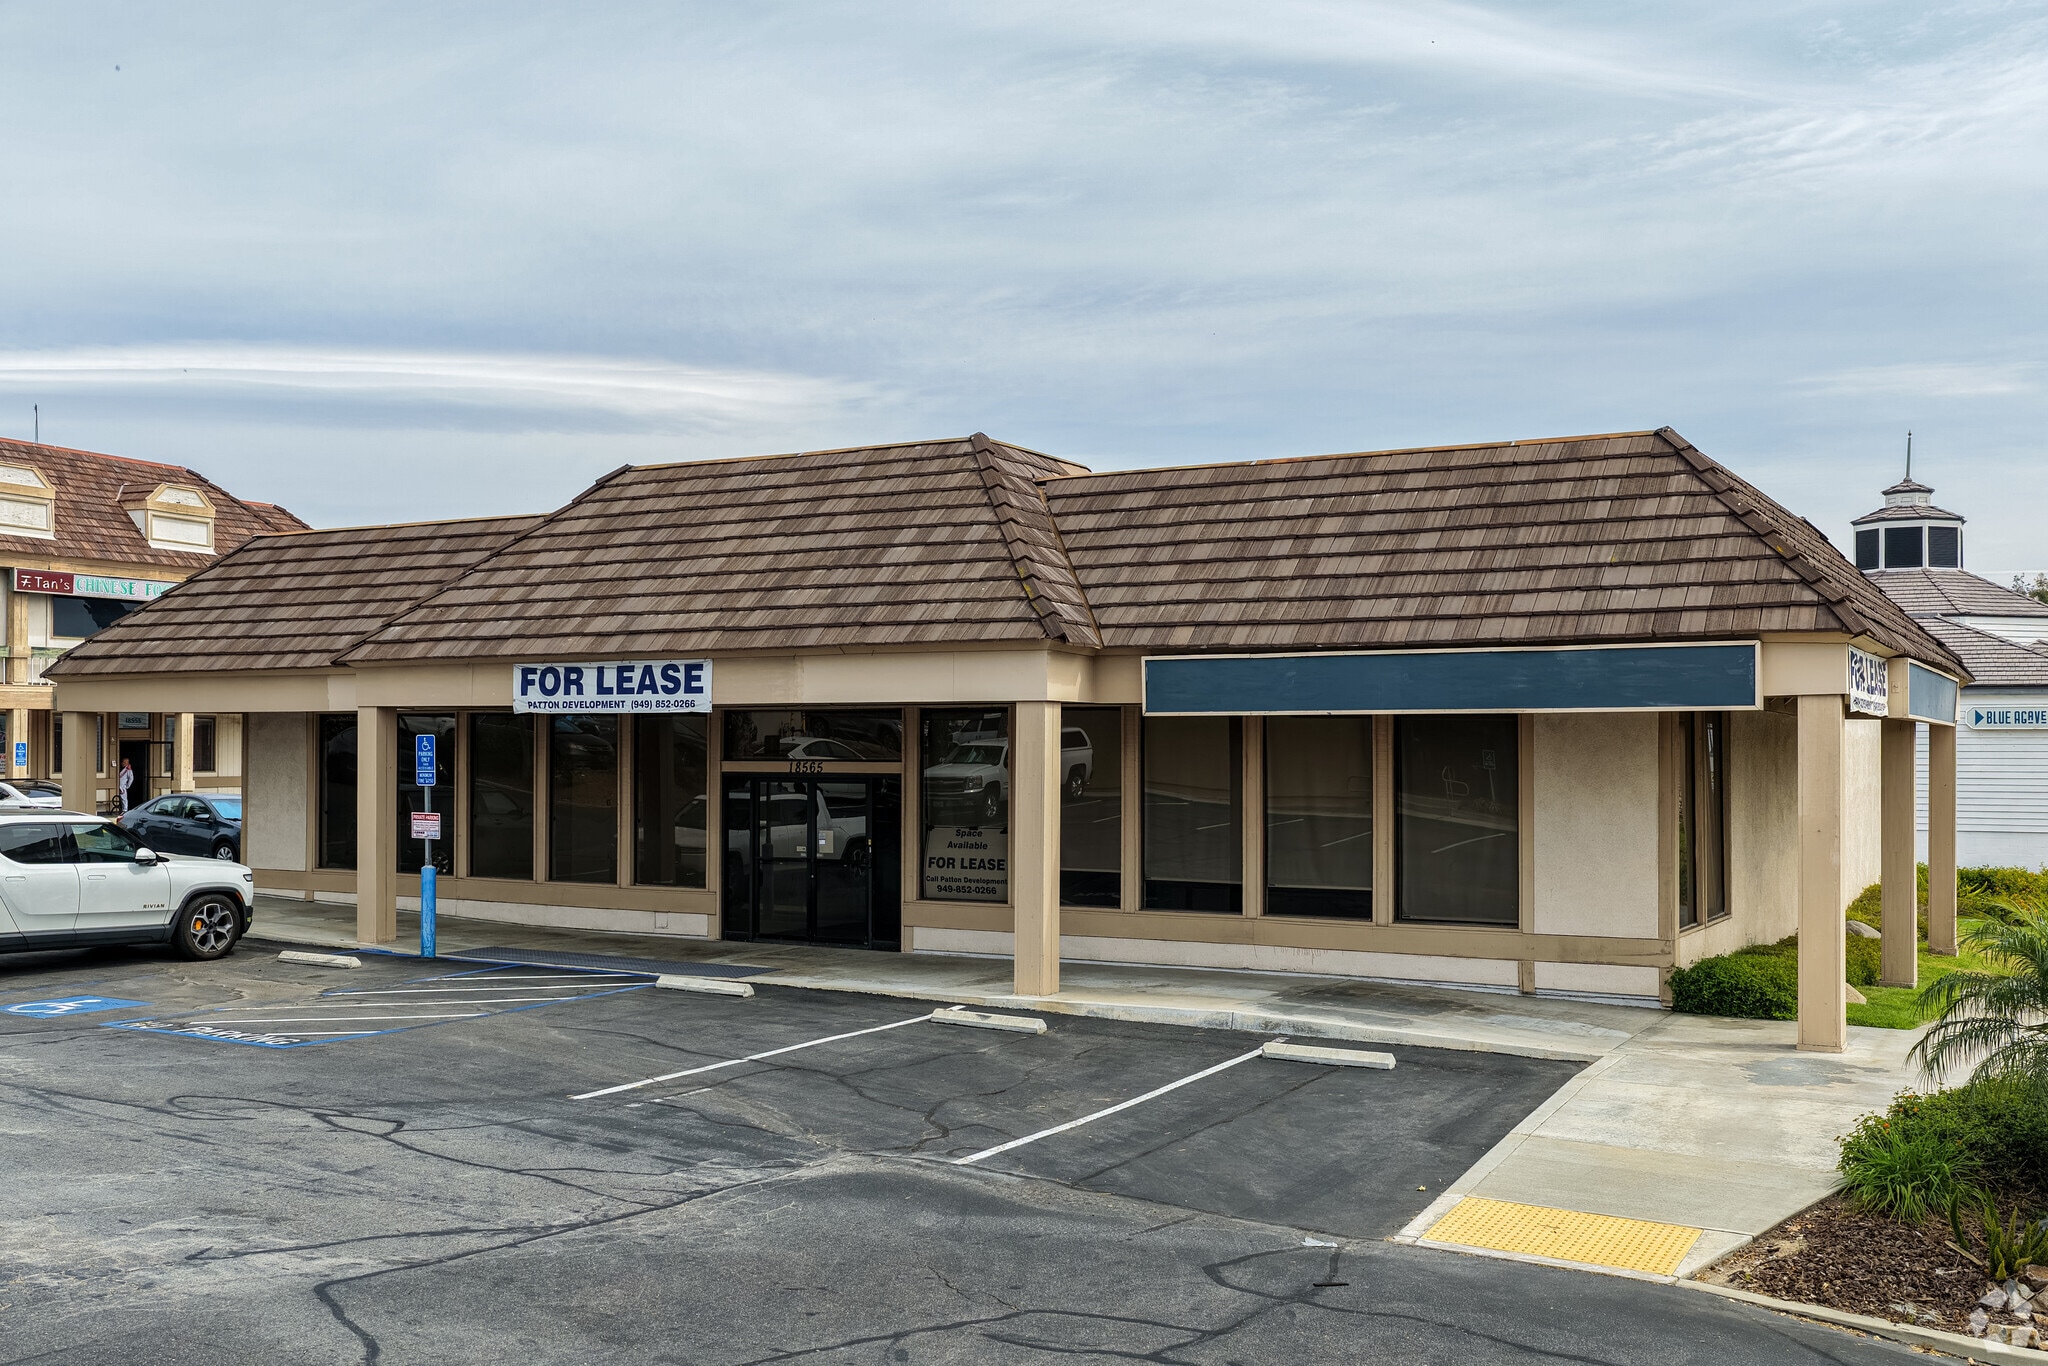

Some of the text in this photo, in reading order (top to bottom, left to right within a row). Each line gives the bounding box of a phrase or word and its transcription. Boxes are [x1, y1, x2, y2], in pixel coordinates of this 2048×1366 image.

[34, 576, 71, 591] Tan's
[75, 576, 138, 596] CHINESE
[1850, 650, 1865, 692] FOR
[520, 663, 704, 697] FOR LEASE
[527, 699, 696, 710] PATTON DEVELOPMENT (949) 852-0266
[1986, 710, 2047, 724] BLUE AGAVE
[789, 761, 824, 773] 18565
[955, 829, 983, 839] Space
[947, 841, 988, 850] Available
[928, 856, 1006, 871] FOR LEASE
[963, 877, 1008, 885] Development
[937, 885, 997, 895] 949-852-0266
[172, 1026, 301, 1045] PARKING
